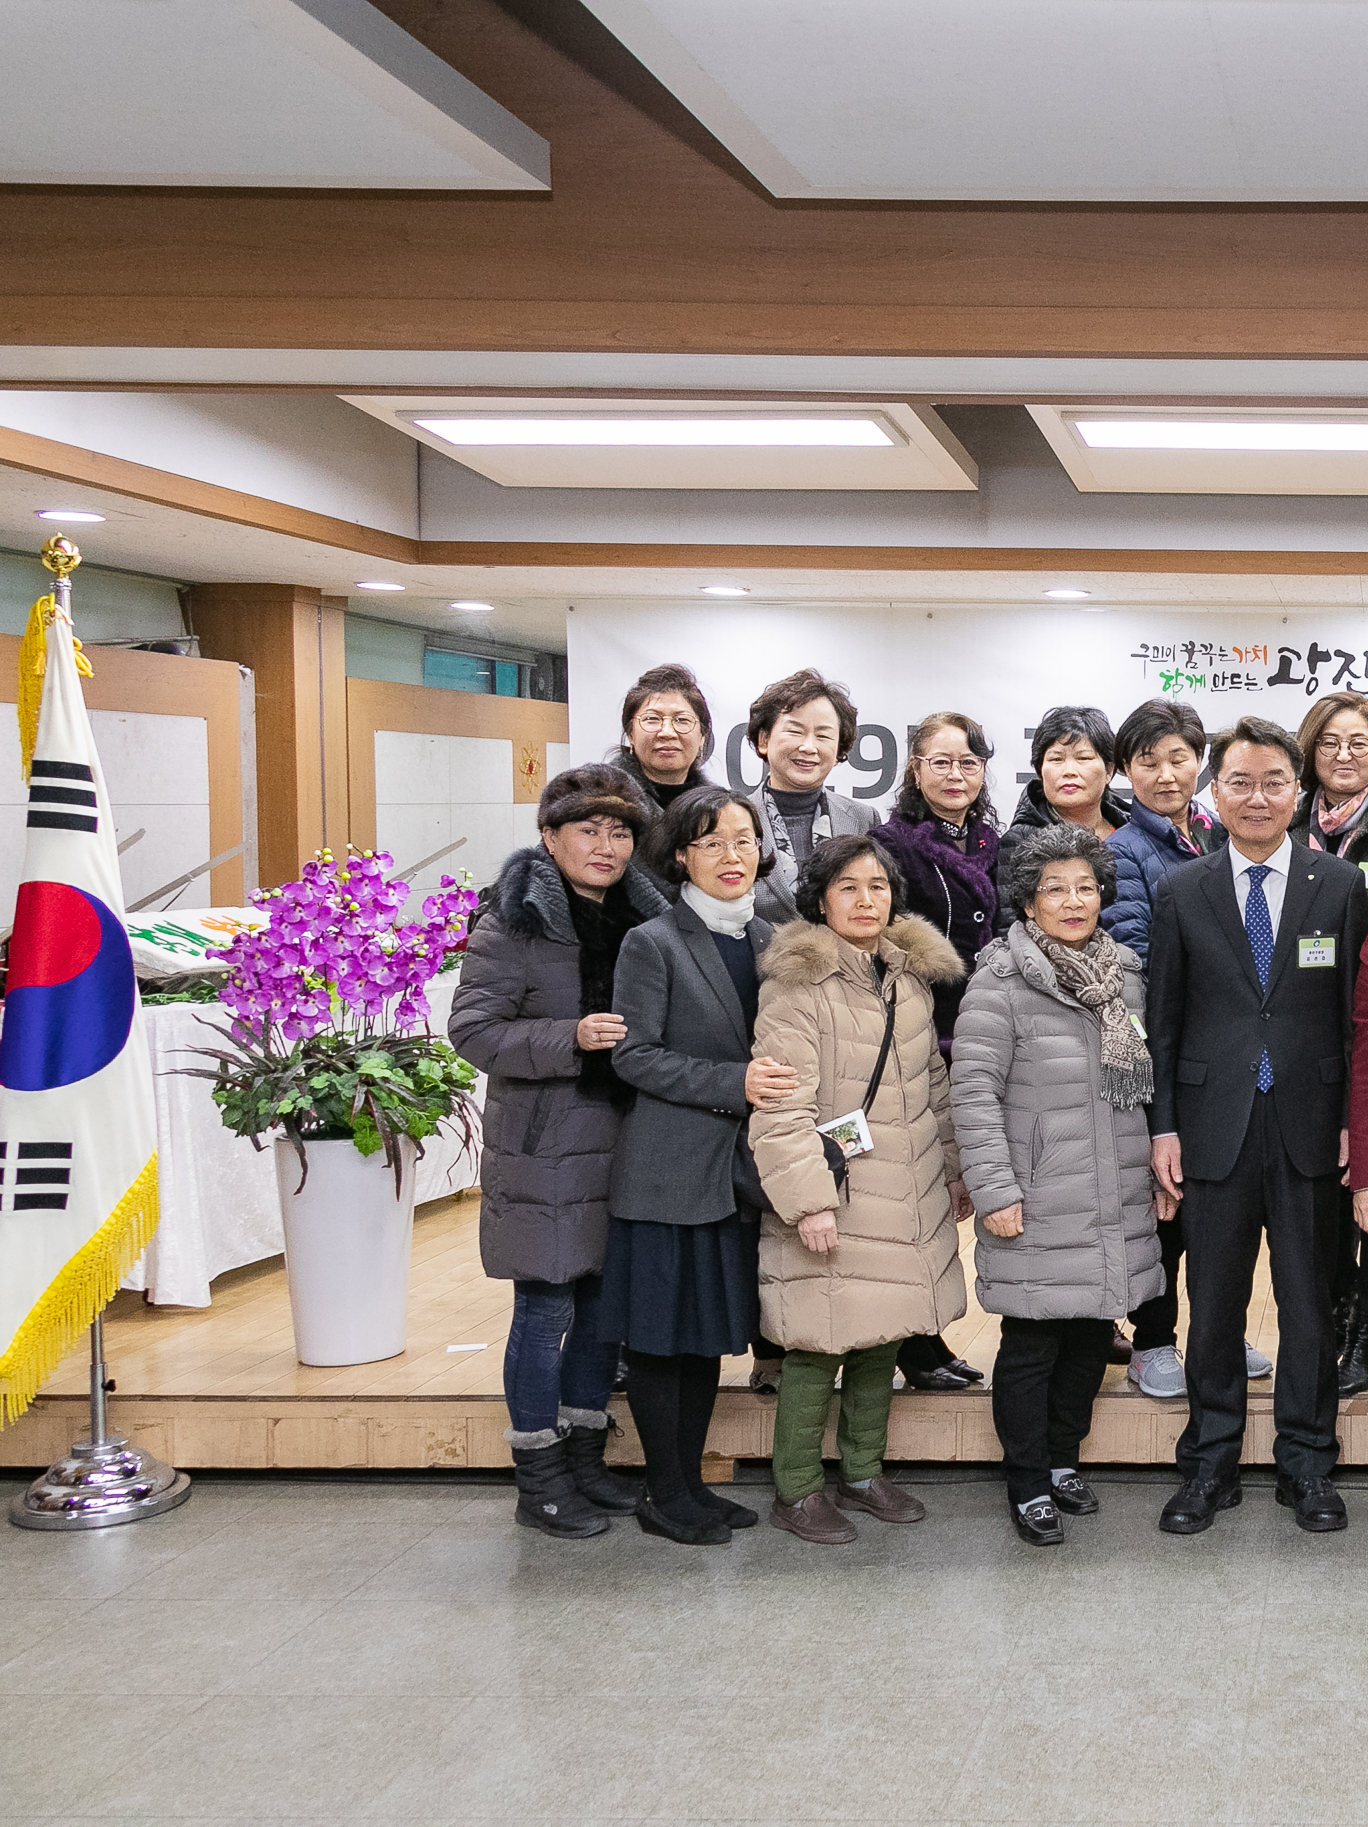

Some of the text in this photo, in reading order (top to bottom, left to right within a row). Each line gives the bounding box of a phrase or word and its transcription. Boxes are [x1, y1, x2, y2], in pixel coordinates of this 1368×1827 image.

[1131, 641, 1268, 679] 구민이 꿈꾸는 가치
[1159, 667, 1263, 698] 함께 만드는
